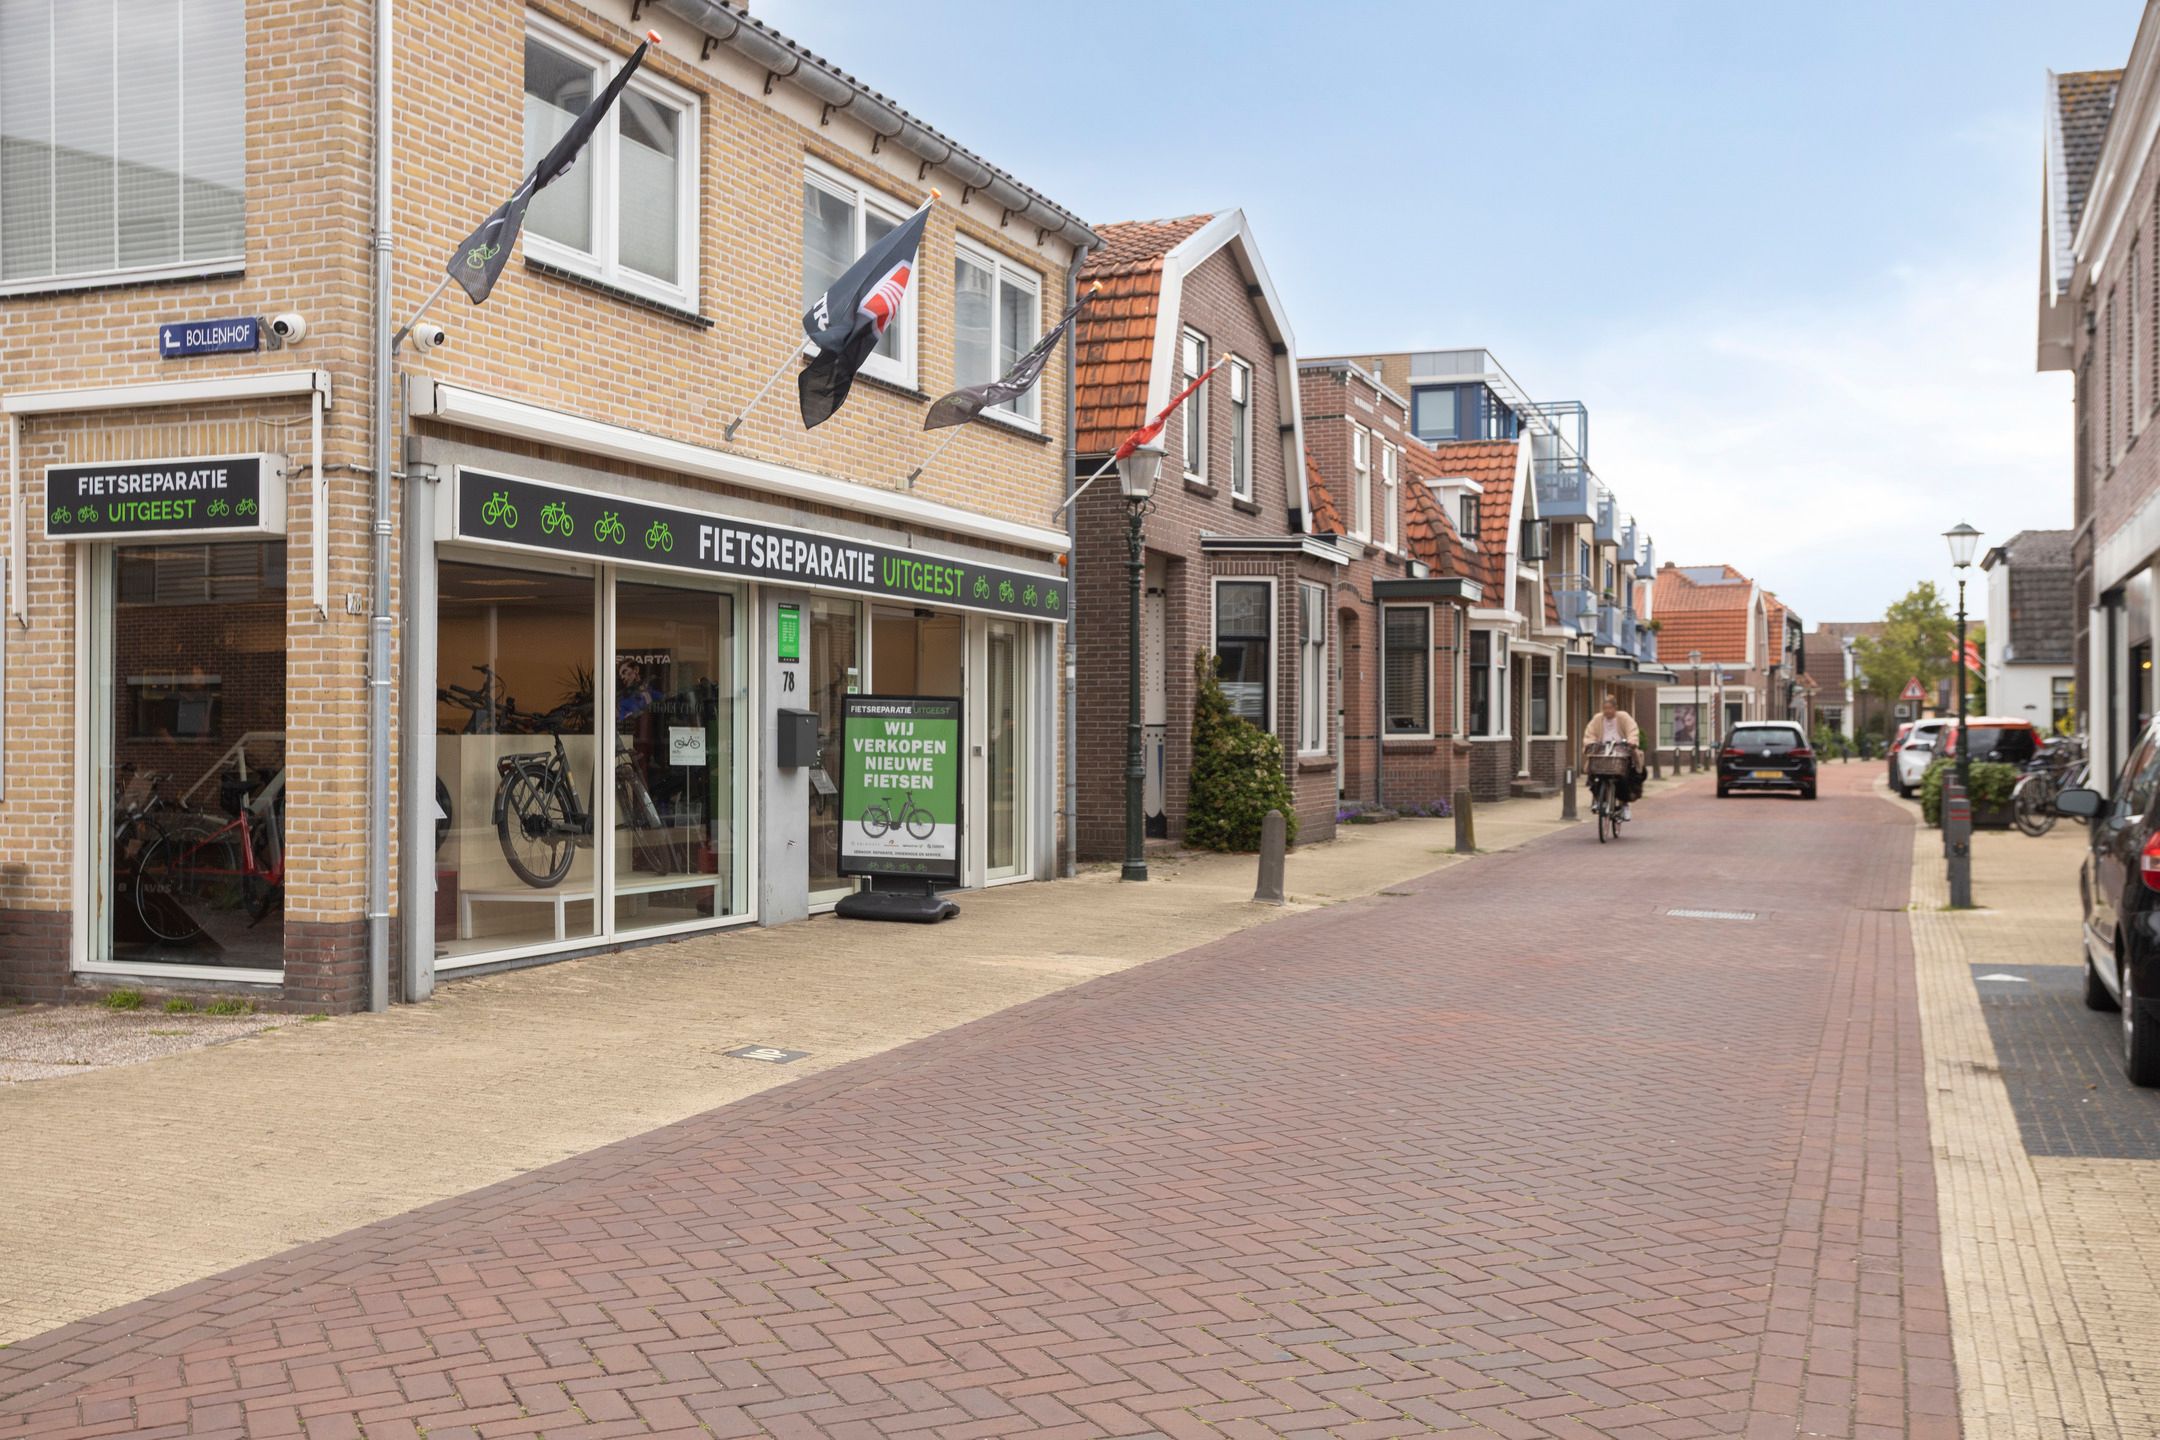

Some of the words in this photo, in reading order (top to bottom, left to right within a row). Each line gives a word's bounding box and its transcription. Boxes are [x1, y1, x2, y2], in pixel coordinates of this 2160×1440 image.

[186, 324, 250, 347] BOLLENHOF
[78, 469, 228, 496] FIETSREPARATIE
[108, 499, 196, 523] UITGEEST
[699, 524, 875, 584] FIETSREPARATIE
[883, 556, 965, 598] UITGEEST
[782, 670, 795, 692] 78
[850, 705, 912, 714] FIETSREPARATIE
[913, 706, 950, 714] UITGEEST
[884, 721, 914, 736] WIJ
[853, 738, 947, 754] VERKOPEN
[865, 756, 933, 771] NIEUWE
[864, 773, 933, 789] FIETSEN
